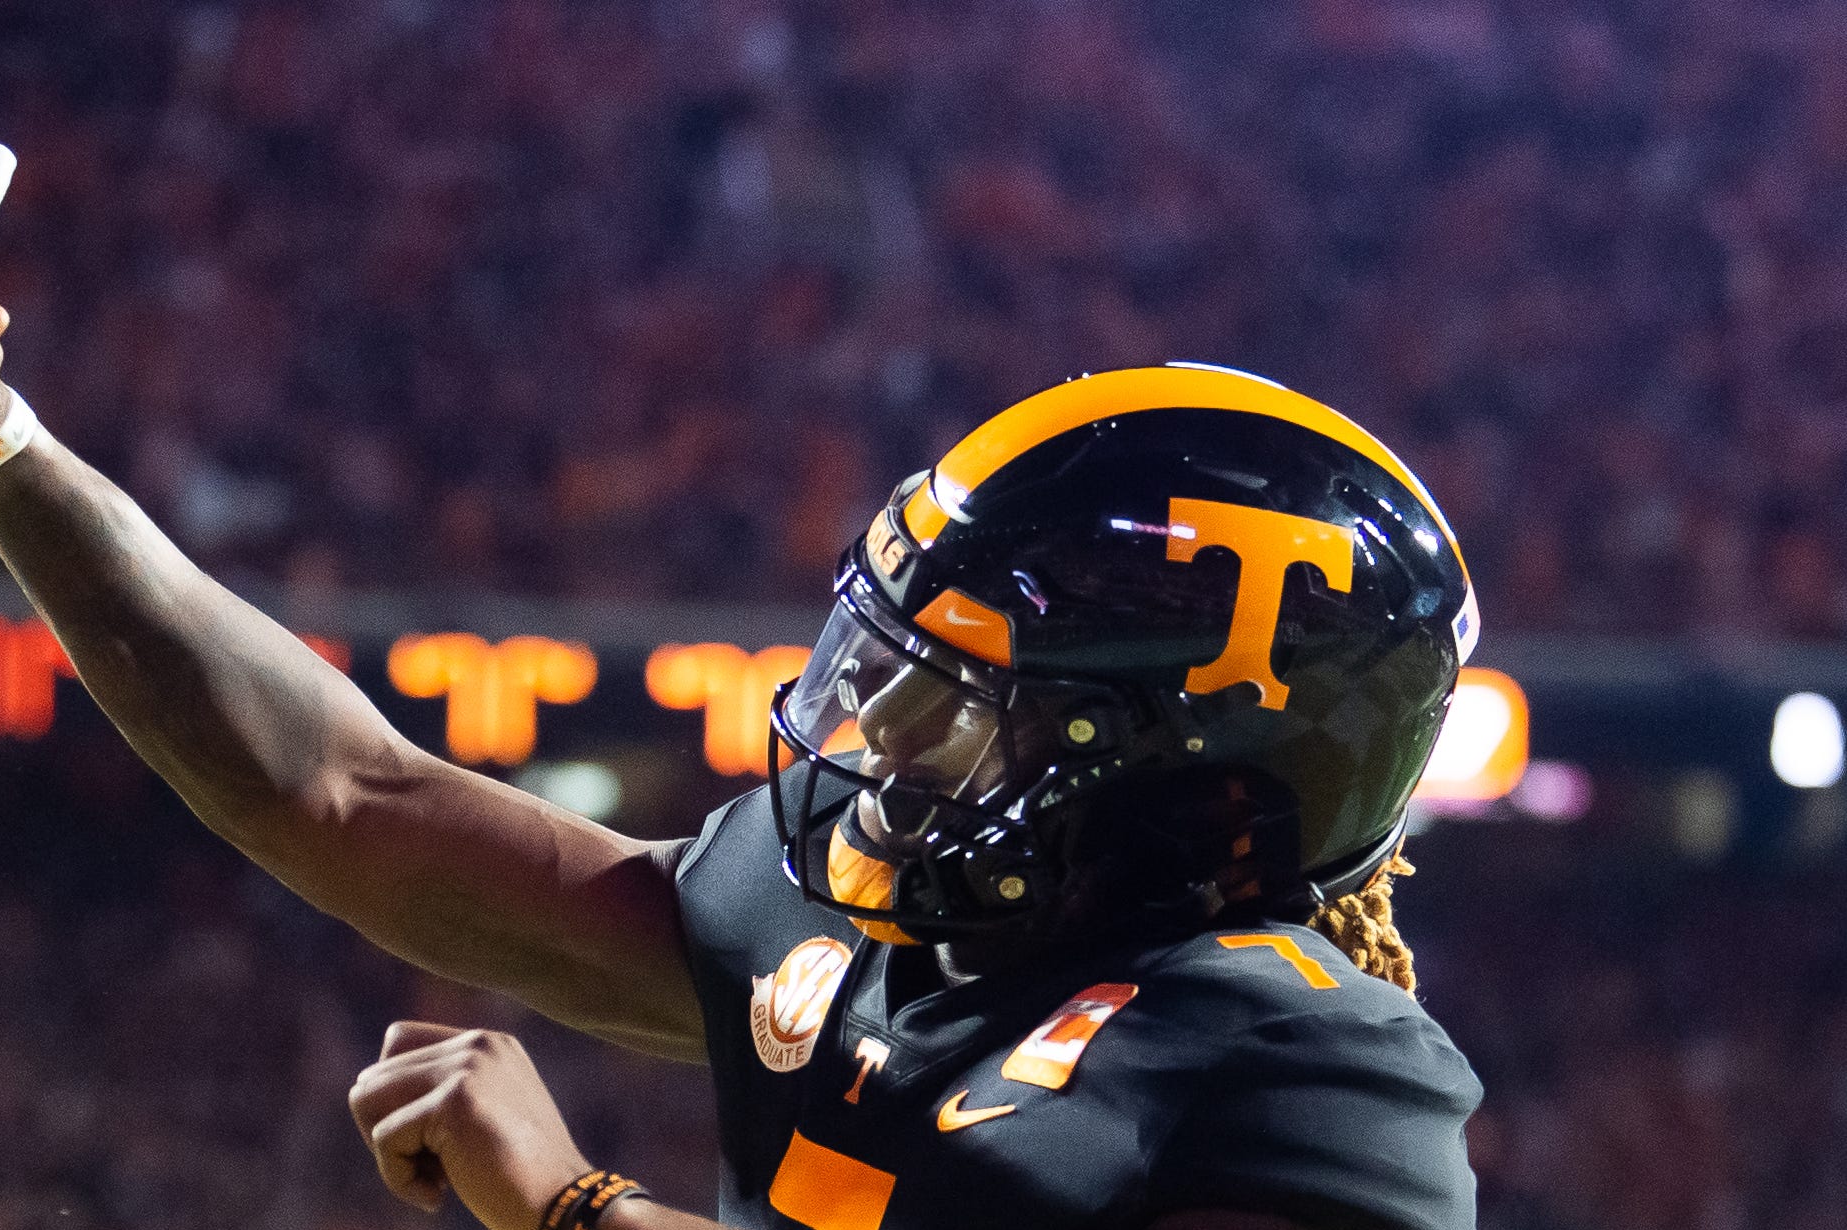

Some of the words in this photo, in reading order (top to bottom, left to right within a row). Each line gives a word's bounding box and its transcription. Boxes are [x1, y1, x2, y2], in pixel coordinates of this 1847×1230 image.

[1166, 497, 1354, 711] T
[1217, 935, 1340, 989] 7
[753, 1004, 807, 1067] GRADUATE
[844, 1037, 892, 1104] T
